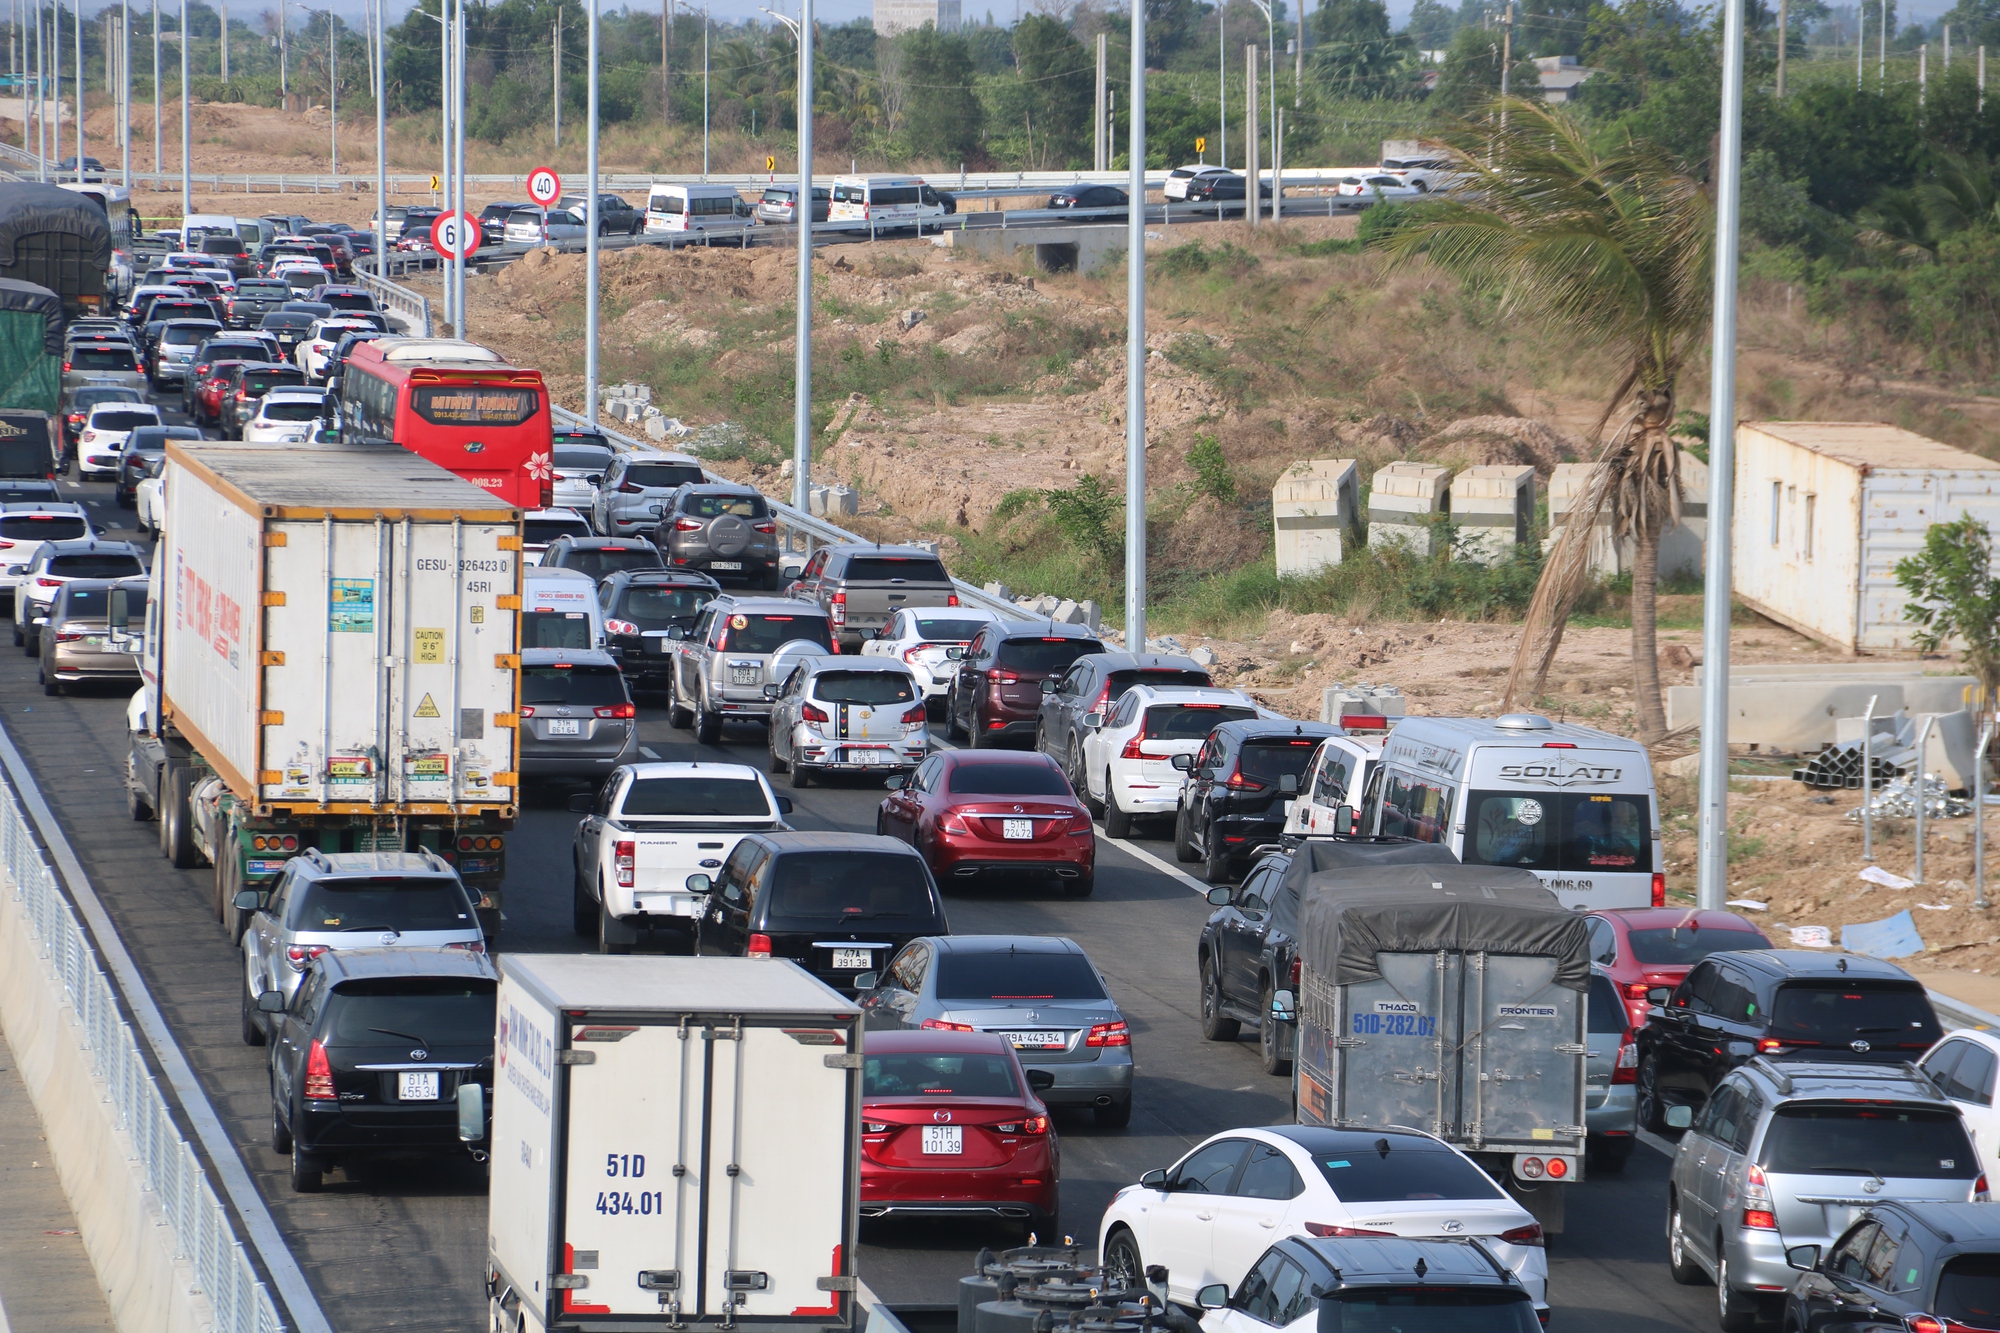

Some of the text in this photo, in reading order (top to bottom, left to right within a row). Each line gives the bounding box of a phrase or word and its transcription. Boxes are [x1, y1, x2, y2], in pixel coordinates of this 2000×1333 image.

[537, 178, 551, 194] 40
[430, 396, 519, 412] MINH HẠNH
[458, 559, 498, 572] 926423
[415, 631, 443, 640] CAUTION
[421, 652, 437, 661] HIGH
[1498, 765, 1623, 780] SOLATI
[1010, 820, 1026, 828] 51H
[1005, 829, 1032, 838] 724.72
[837, 958, 868, 967] 391.38
[1378, 1003, 1416, 1012] THACO
[1500, 1006, 1555, 1016] FRONTIER
[1353, 1013, 1436, 1037] 51D-282.07
[408, 1073, 429, 1086] 61A
[401, 1086, 438, 1098] 455.34
[931, 1126, 953, 1140] 51H
[924, 1140, 961, 1153] 101.39
[606, 1153, 646, 1178] 51D
[595, 1191, 662, 1216] 434.01
